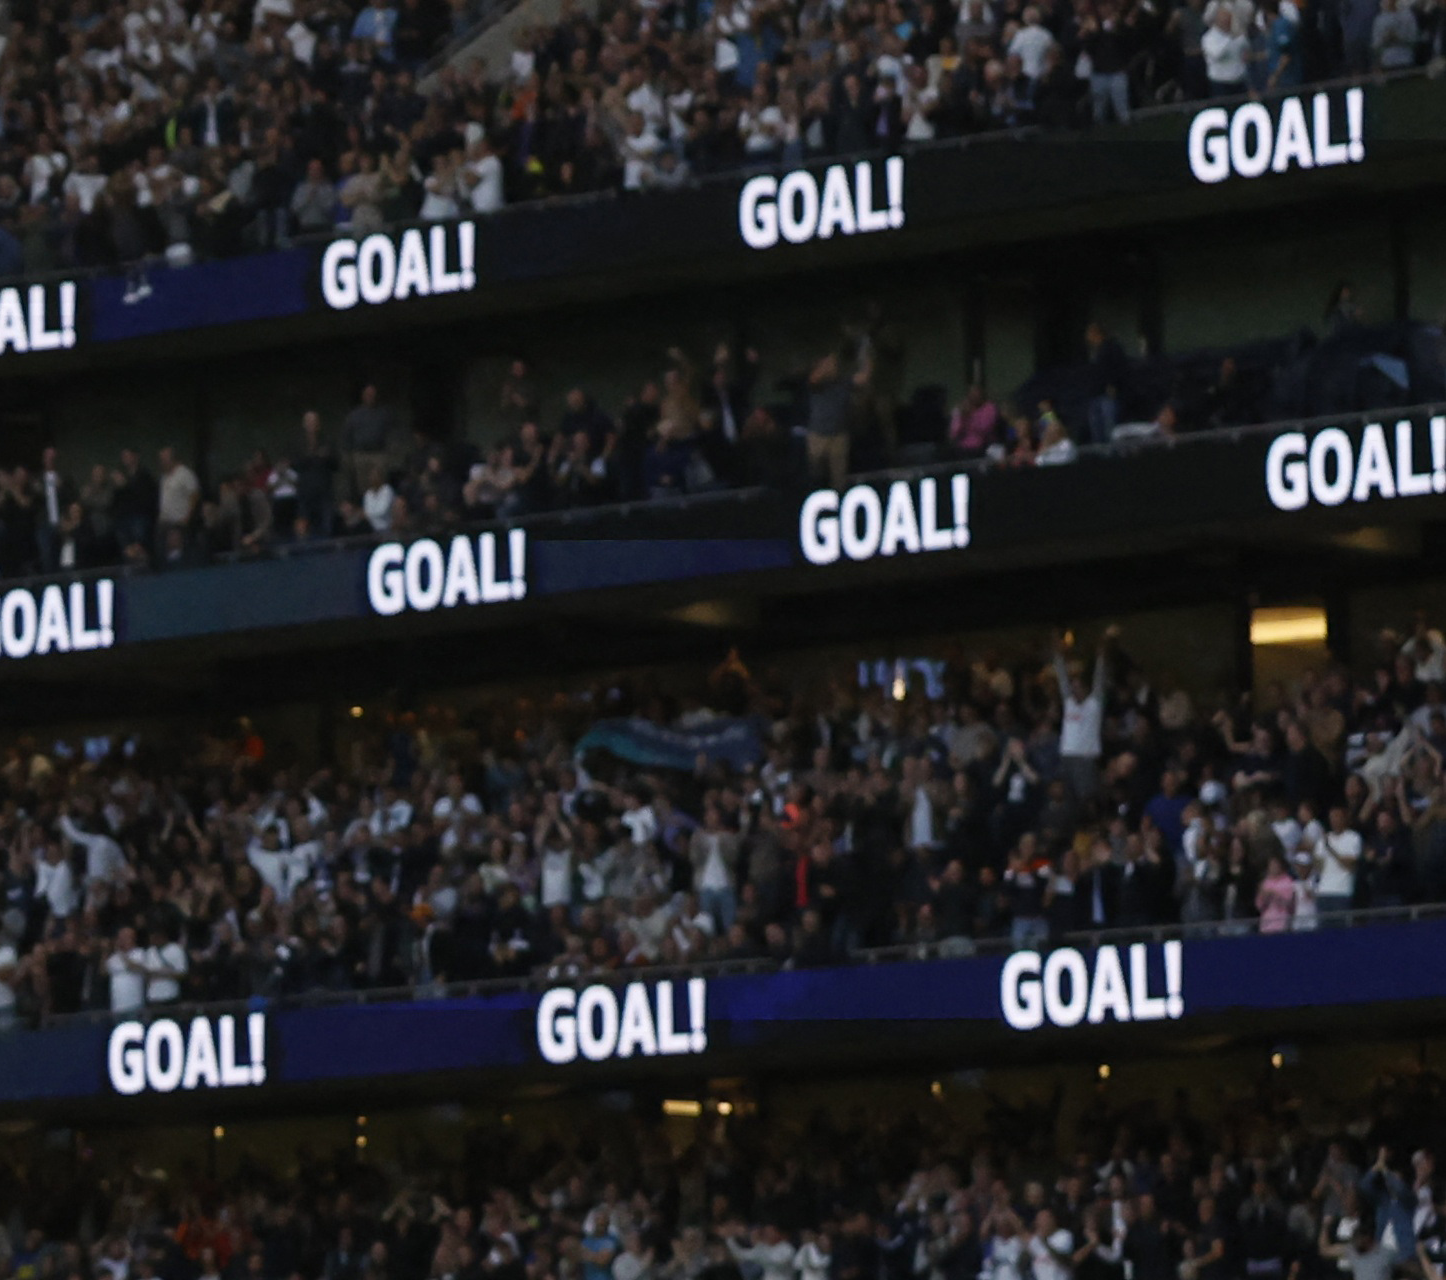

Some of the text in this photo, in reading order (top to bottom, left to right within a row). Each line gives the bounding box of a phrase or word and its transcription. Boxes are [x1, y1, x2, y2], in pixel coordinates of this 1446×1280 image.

[1189, 88, 1364, 183] GOAL!
[739, 157, 904, 248] GOAL!
[322, 221, 475, 309] GOAL!
[1267, 417, 1446, 510] GOAL!
[800, 474, 969, 564] GOAL!
[368, 529, 526, 614] GOAL!
[537, 978, 707, 1063] GOAL!
[1001, 940, 1184, 1029] GOAL!
[109, 1013, 266, 1094] GOAL!
